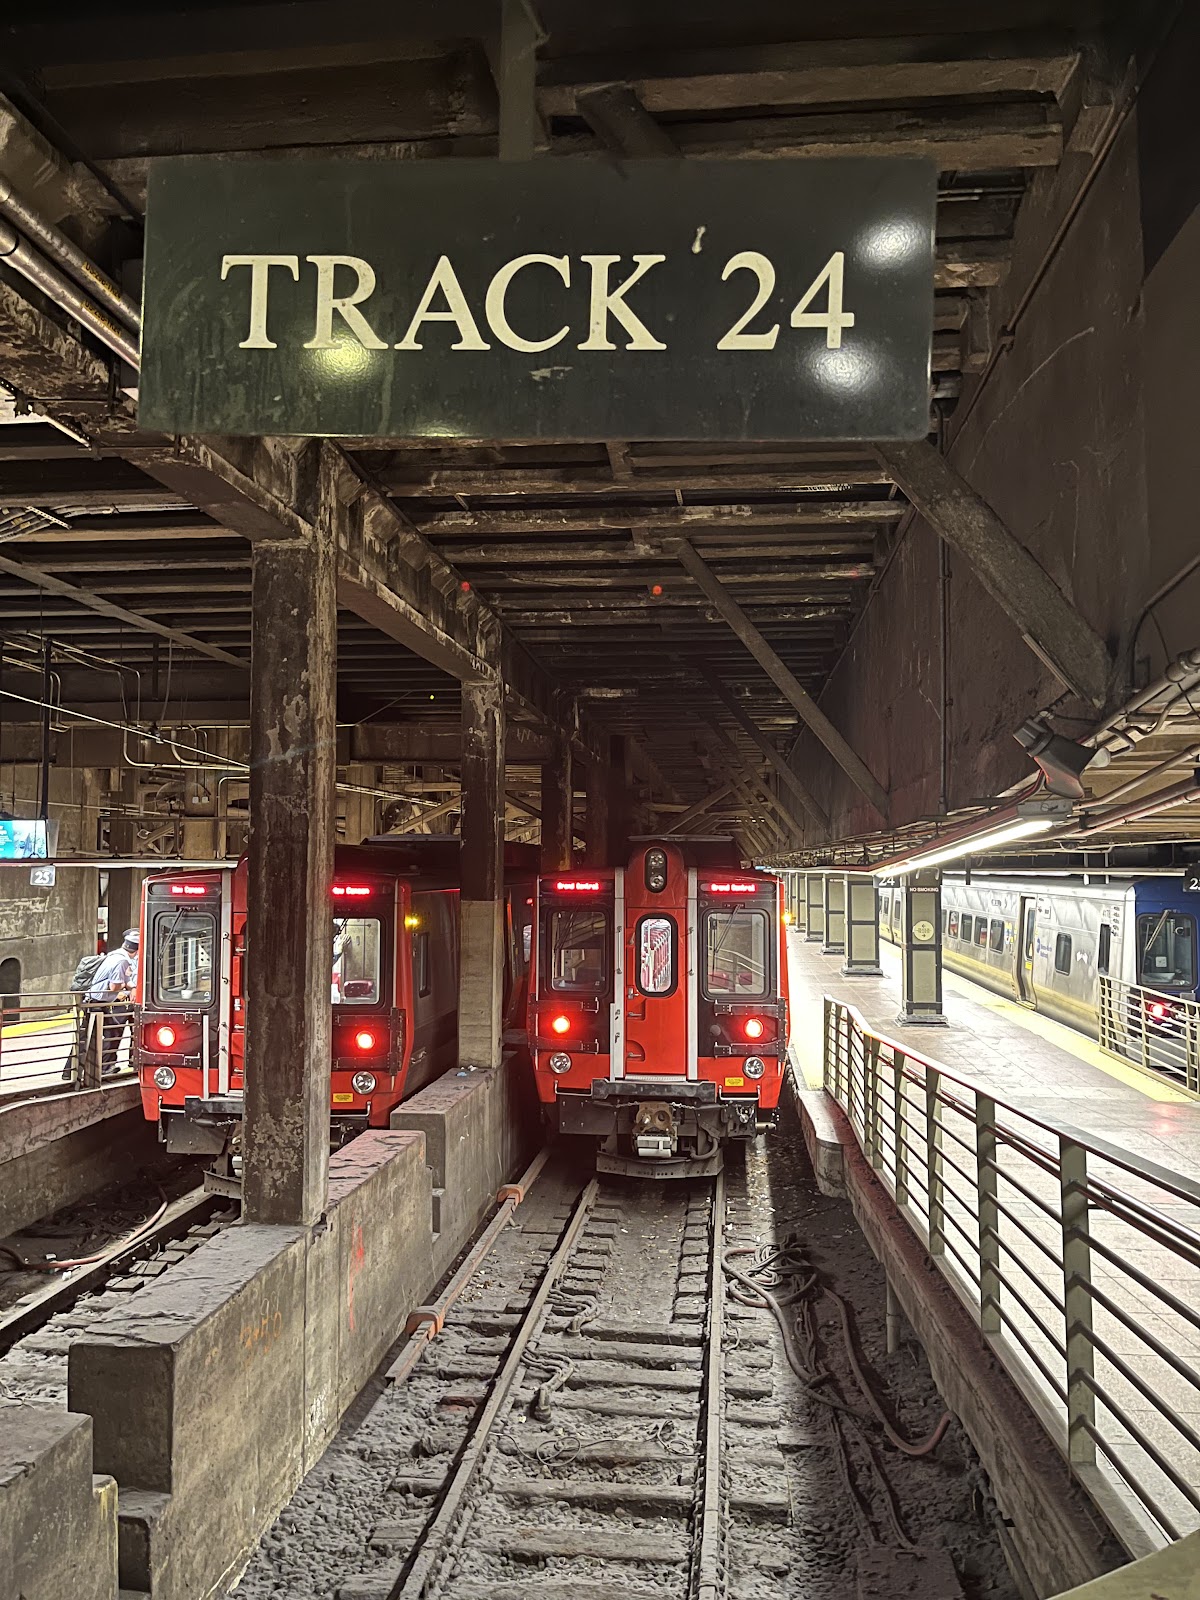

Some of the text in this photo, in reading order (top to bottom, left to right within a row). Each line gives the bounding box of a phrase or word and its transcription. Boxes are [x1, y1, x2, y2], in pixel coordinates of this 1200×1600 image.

[220, 250, 855, 353] TRACK 24
[34, 870, 51, 884] 25
[878, 876, 896, 887] 24
[1188, 877, 1200, 890] 2
